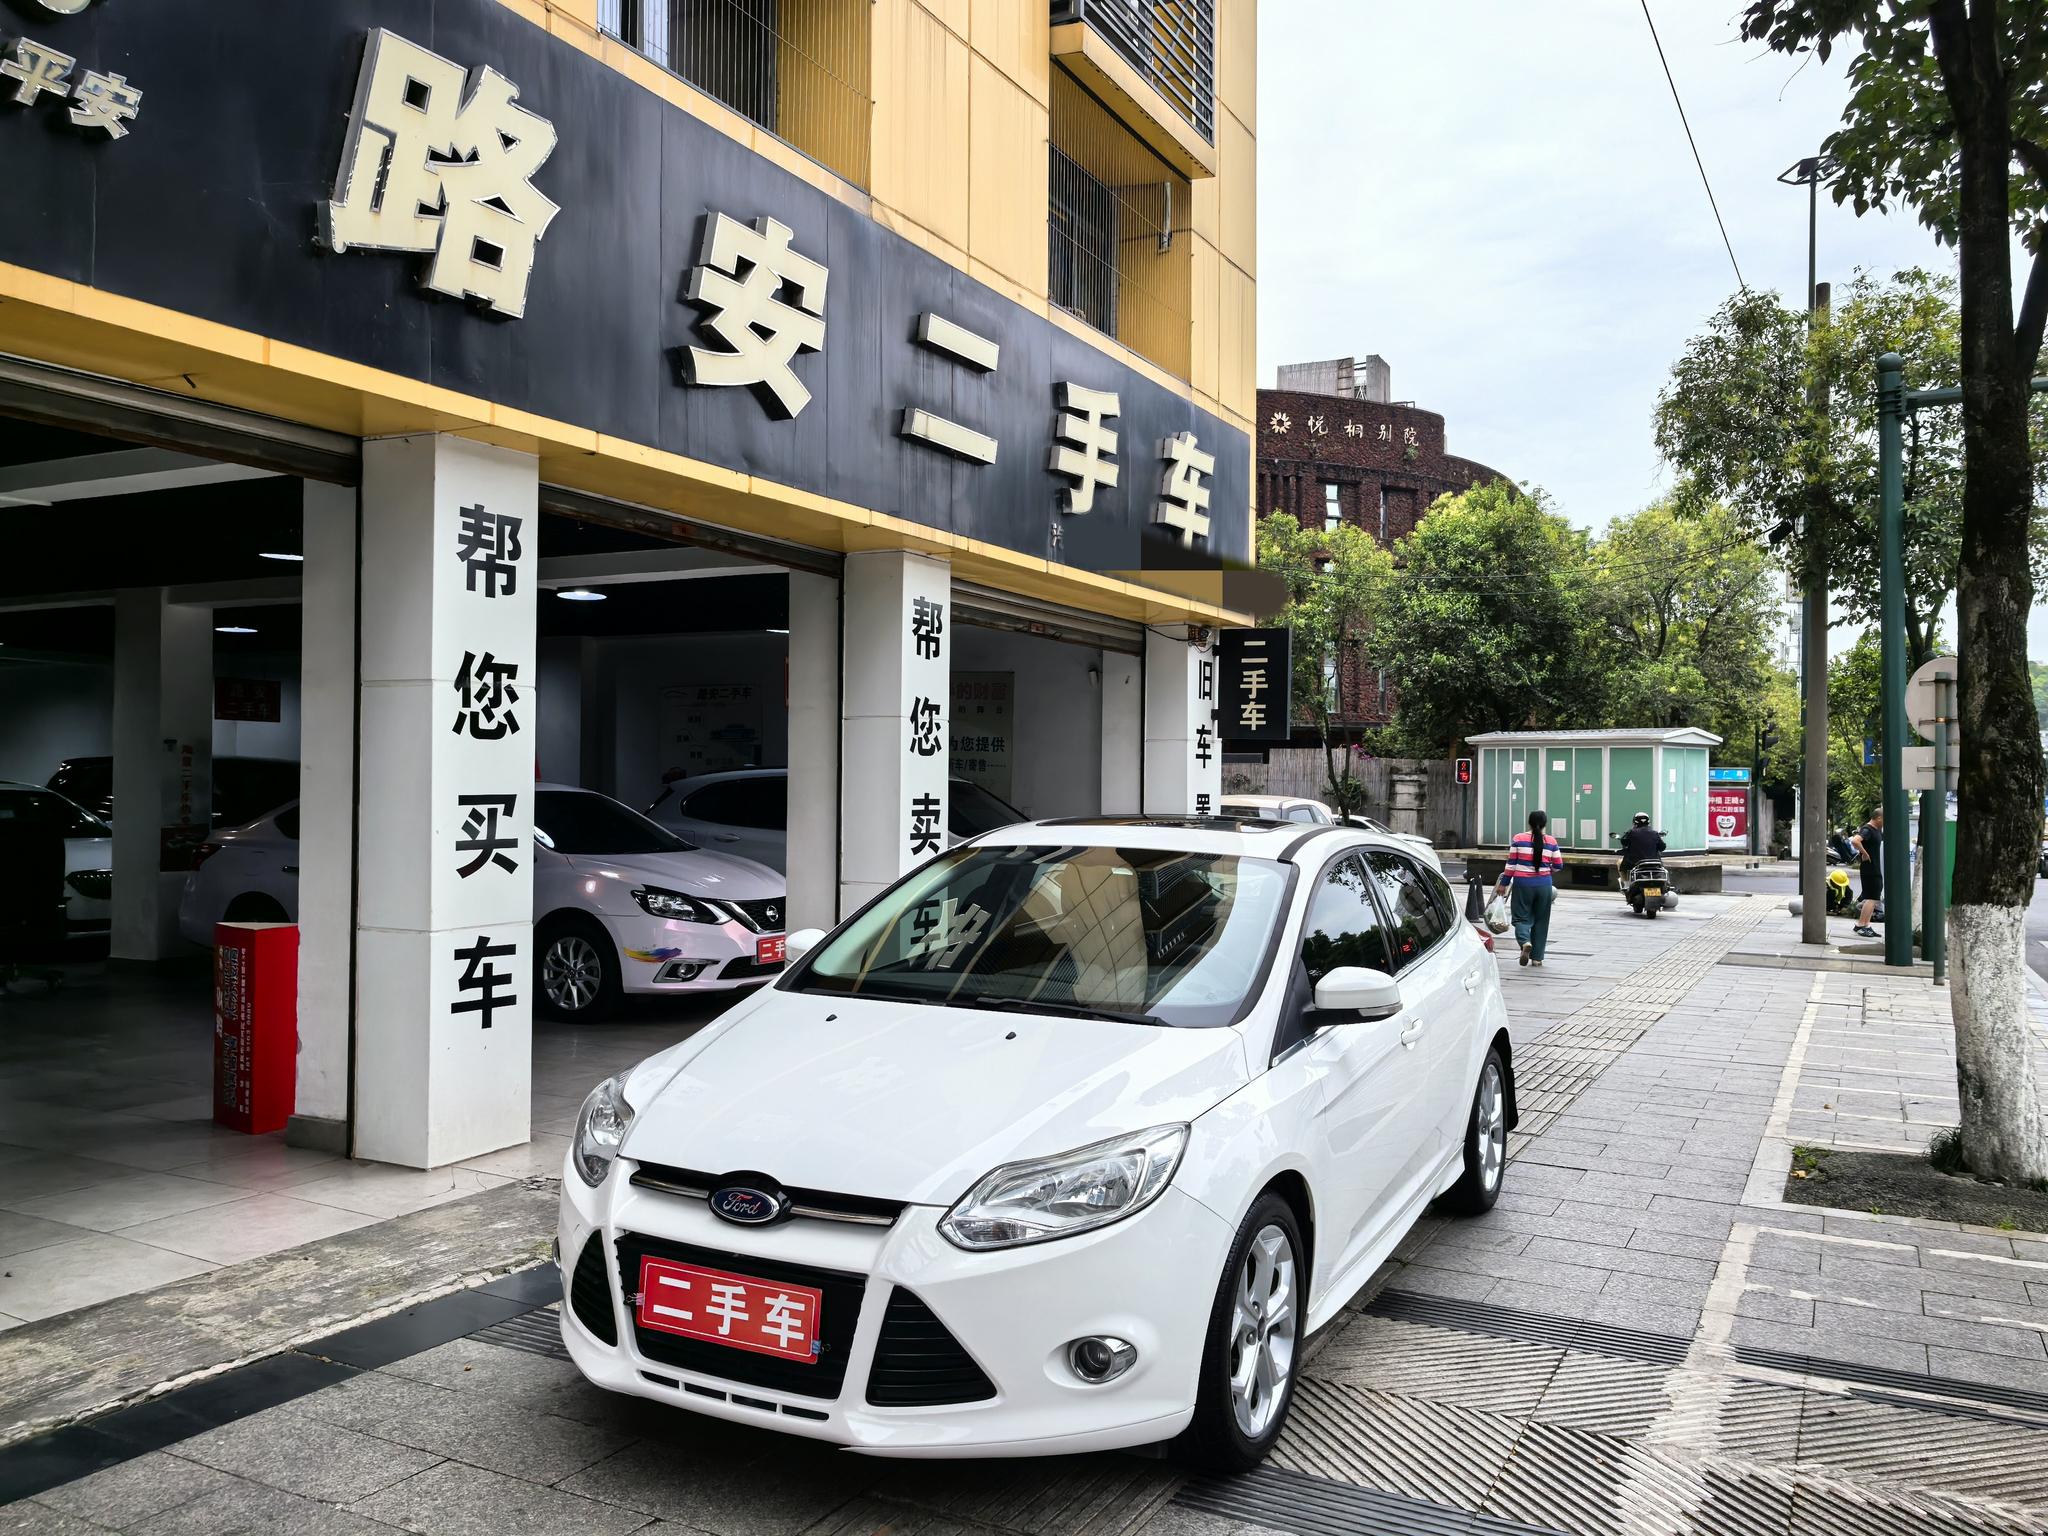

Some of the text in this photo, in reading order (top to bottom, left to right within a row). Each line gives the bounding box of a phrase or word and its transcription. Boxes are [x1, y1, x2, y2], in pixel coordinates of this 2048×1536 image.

[0, 36, 143, 140] 平安
[1307, 415, 1419, 447] 悦桐别院
[1239, 639, 1269, 731] 二手车
[450, 502, 524, 1029] 帮您买车
[722, 1192, 761, 1215] Ford
[652, 1275, 806, 1348] 二手车
